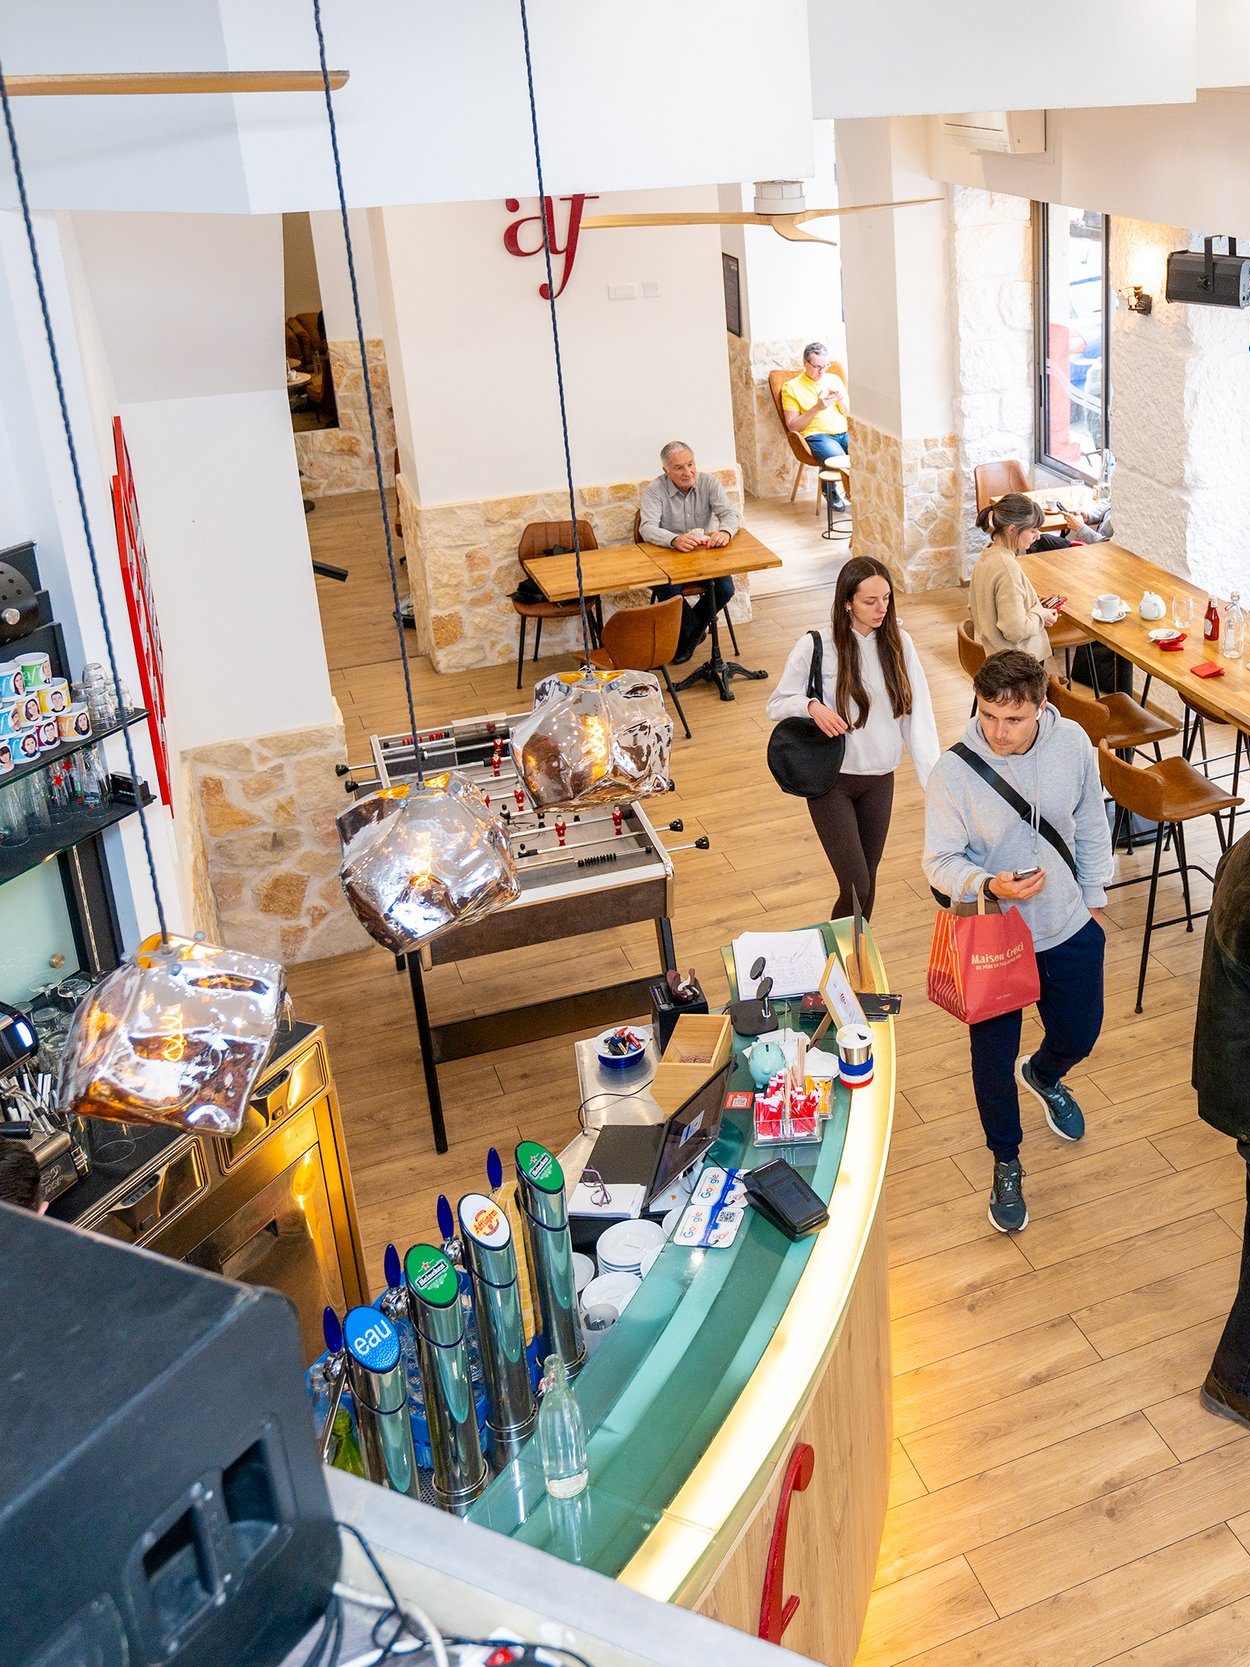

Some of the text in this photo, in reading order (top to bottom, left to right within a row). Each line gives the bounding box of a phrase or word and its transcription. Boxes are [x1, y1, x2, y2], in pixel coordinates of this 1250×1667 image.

[971, 953, 1004, 965] Maison
[701, 1174, 719, 1199] Google
[418, 1262, 447, 1288] Heineken
[354, 1319, 393, 1356] eau
